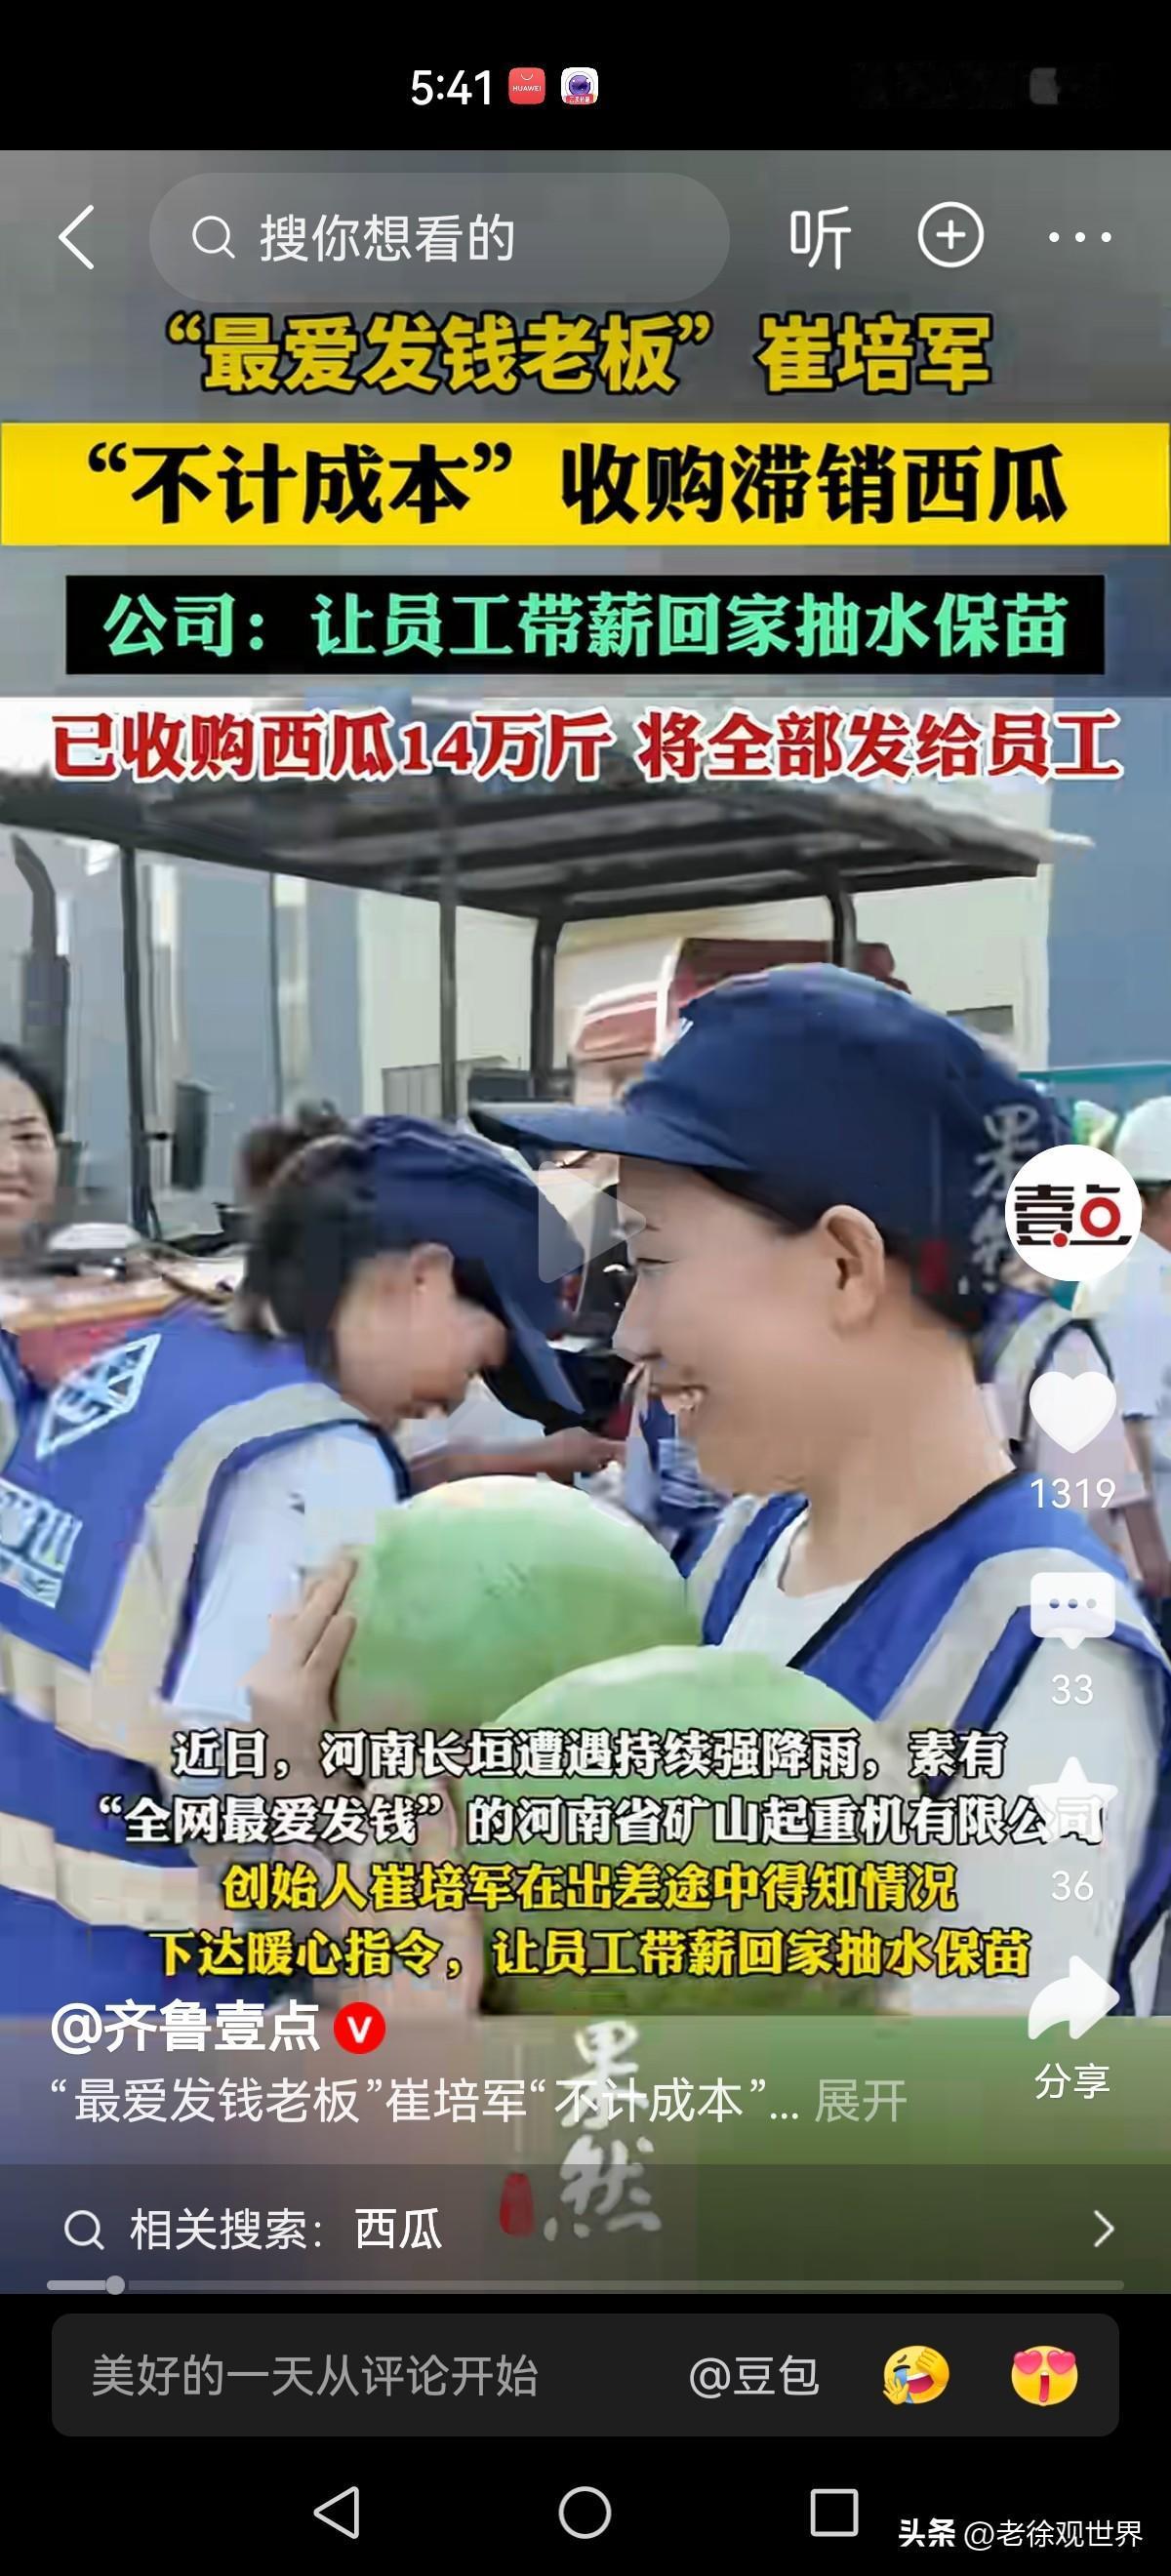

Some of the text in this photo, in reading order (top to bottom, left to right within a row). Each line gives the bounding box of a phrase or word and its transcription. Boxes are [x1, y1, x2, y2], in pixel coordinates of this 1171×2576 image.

[411, 69, 491, 105] 5:41
[260, 213, 515, 263] 搜你想看的
[790, 206, 852, 270] 听
[1030, 1477, 1116, 1509] 1319
[1051, 1673, 1094, 1705] 33
[1051, 1870, 1094, 1901] 36
[51, 1998, 321, 2055] @齐鲁壹点
[815, 2078, 908, 2122] 展开
[1034, 2063, 1110, 2100] 分享
[92, 2354, 539, 2398] 美好的一天从评论开始
[688, 2355, 820, 2399] @豆包
